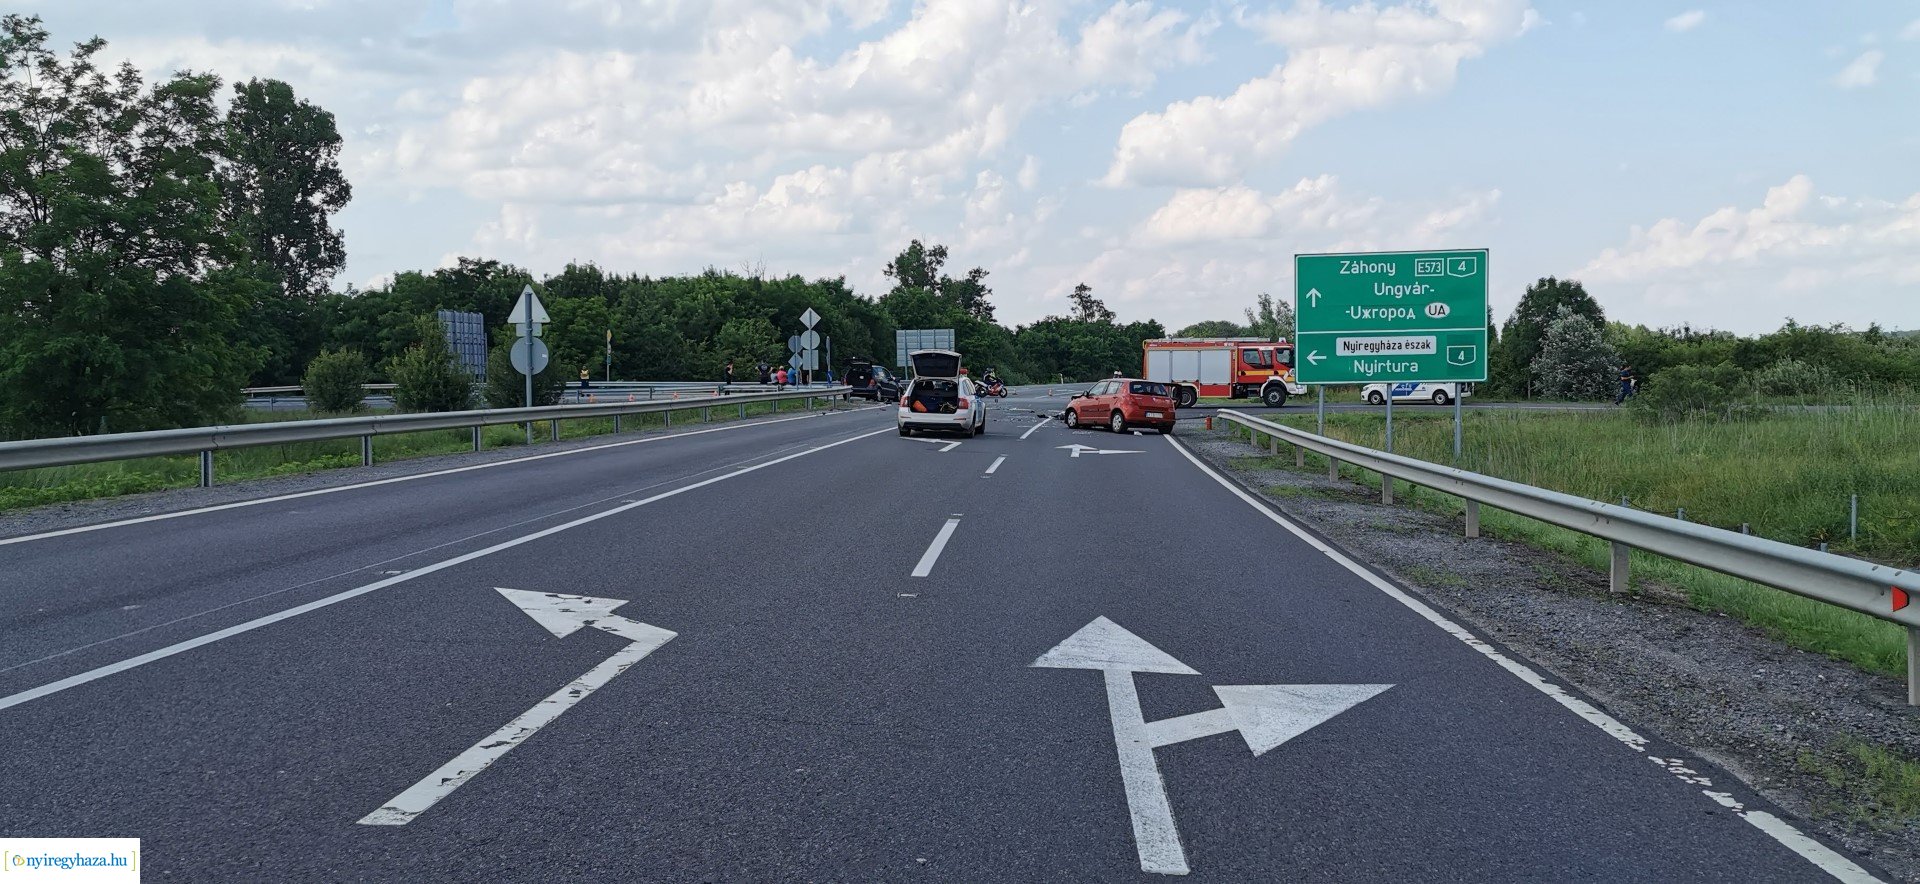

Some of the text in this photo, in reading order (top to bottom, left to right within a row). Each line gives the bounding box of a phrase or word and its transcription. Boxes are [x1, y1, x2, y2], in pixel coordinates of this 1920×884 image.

[1339, 260, 1467, 276] Záhony E573 4
[1374, 281, 1435, 298] Ungvár-
[1428, 305, 1446, 316] UA
[1405, 339, 1431, 350] észak
[1457, 350, 1465, 361] 4
